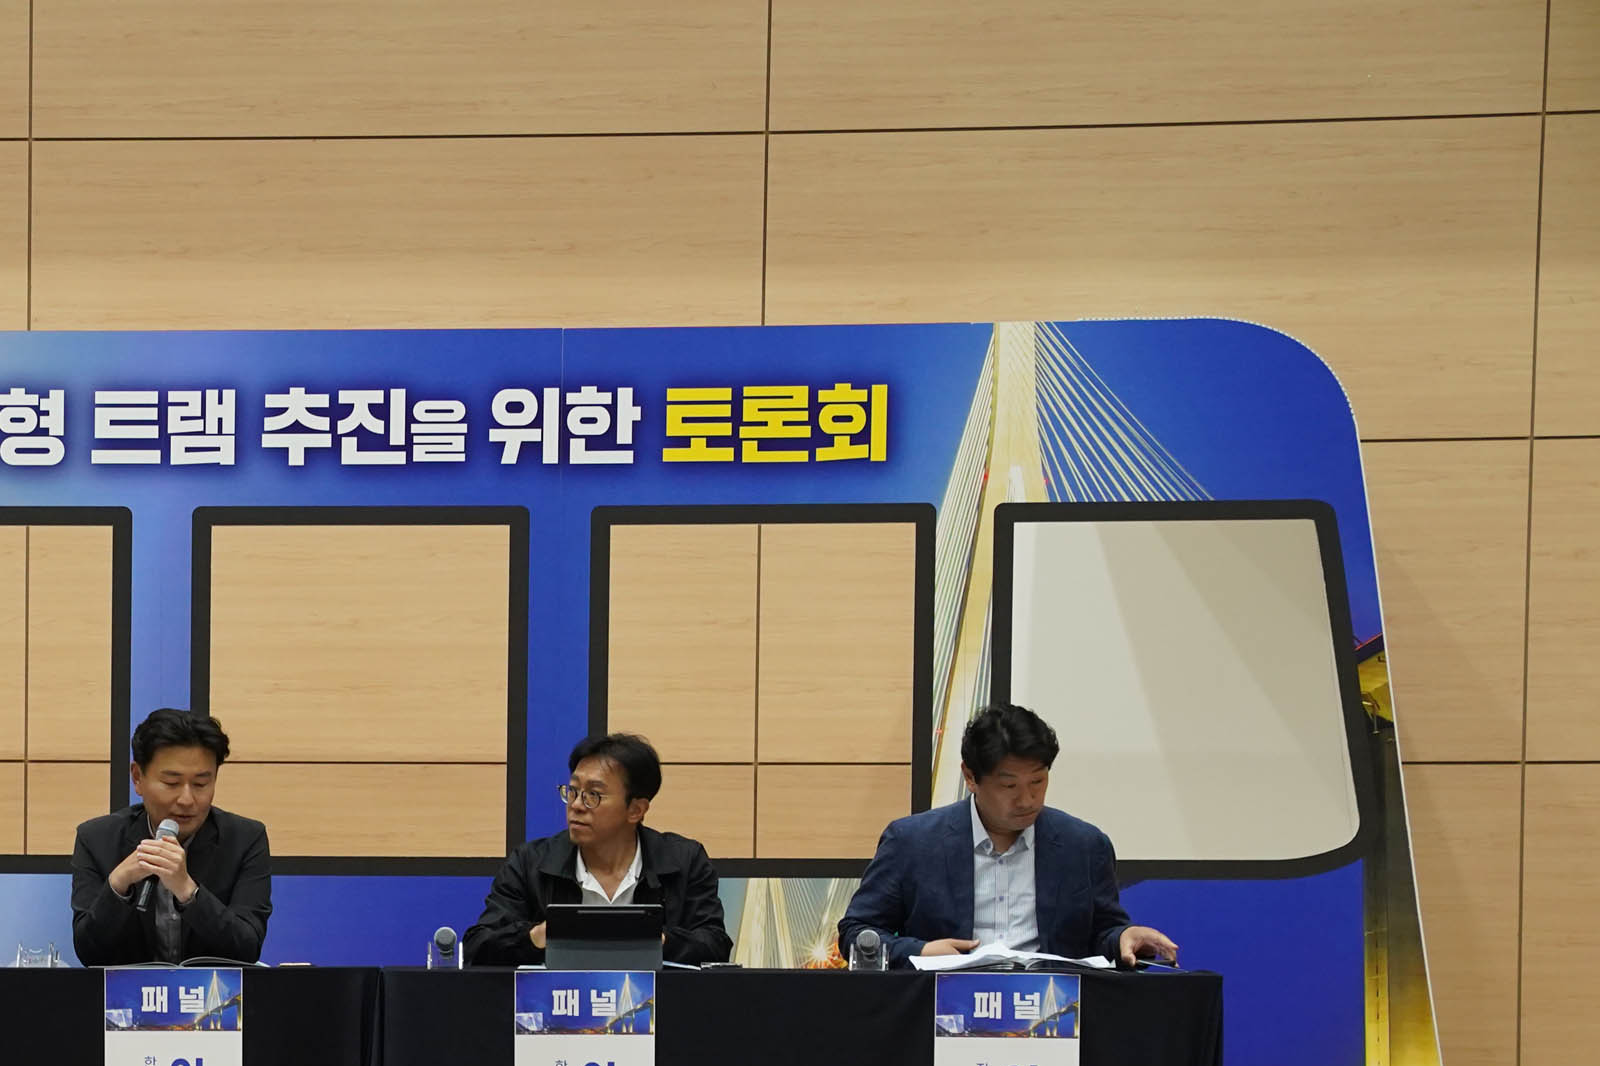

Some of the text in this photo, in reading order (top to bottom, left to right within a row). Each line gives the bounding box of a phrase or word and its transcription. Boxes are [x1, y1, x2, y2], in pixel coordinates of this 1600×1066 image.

[92, 390, 235, 465] 트램
[262, 388, 467, 465] 추진을
[489, 386, 637, 464] 위한
[663, 384, 887, 462] 토론회
[142, 987, 206, 1015] 패널
[552, 990, 617, 1019] 패널
[974, 992, 1042, 1021] 패널
